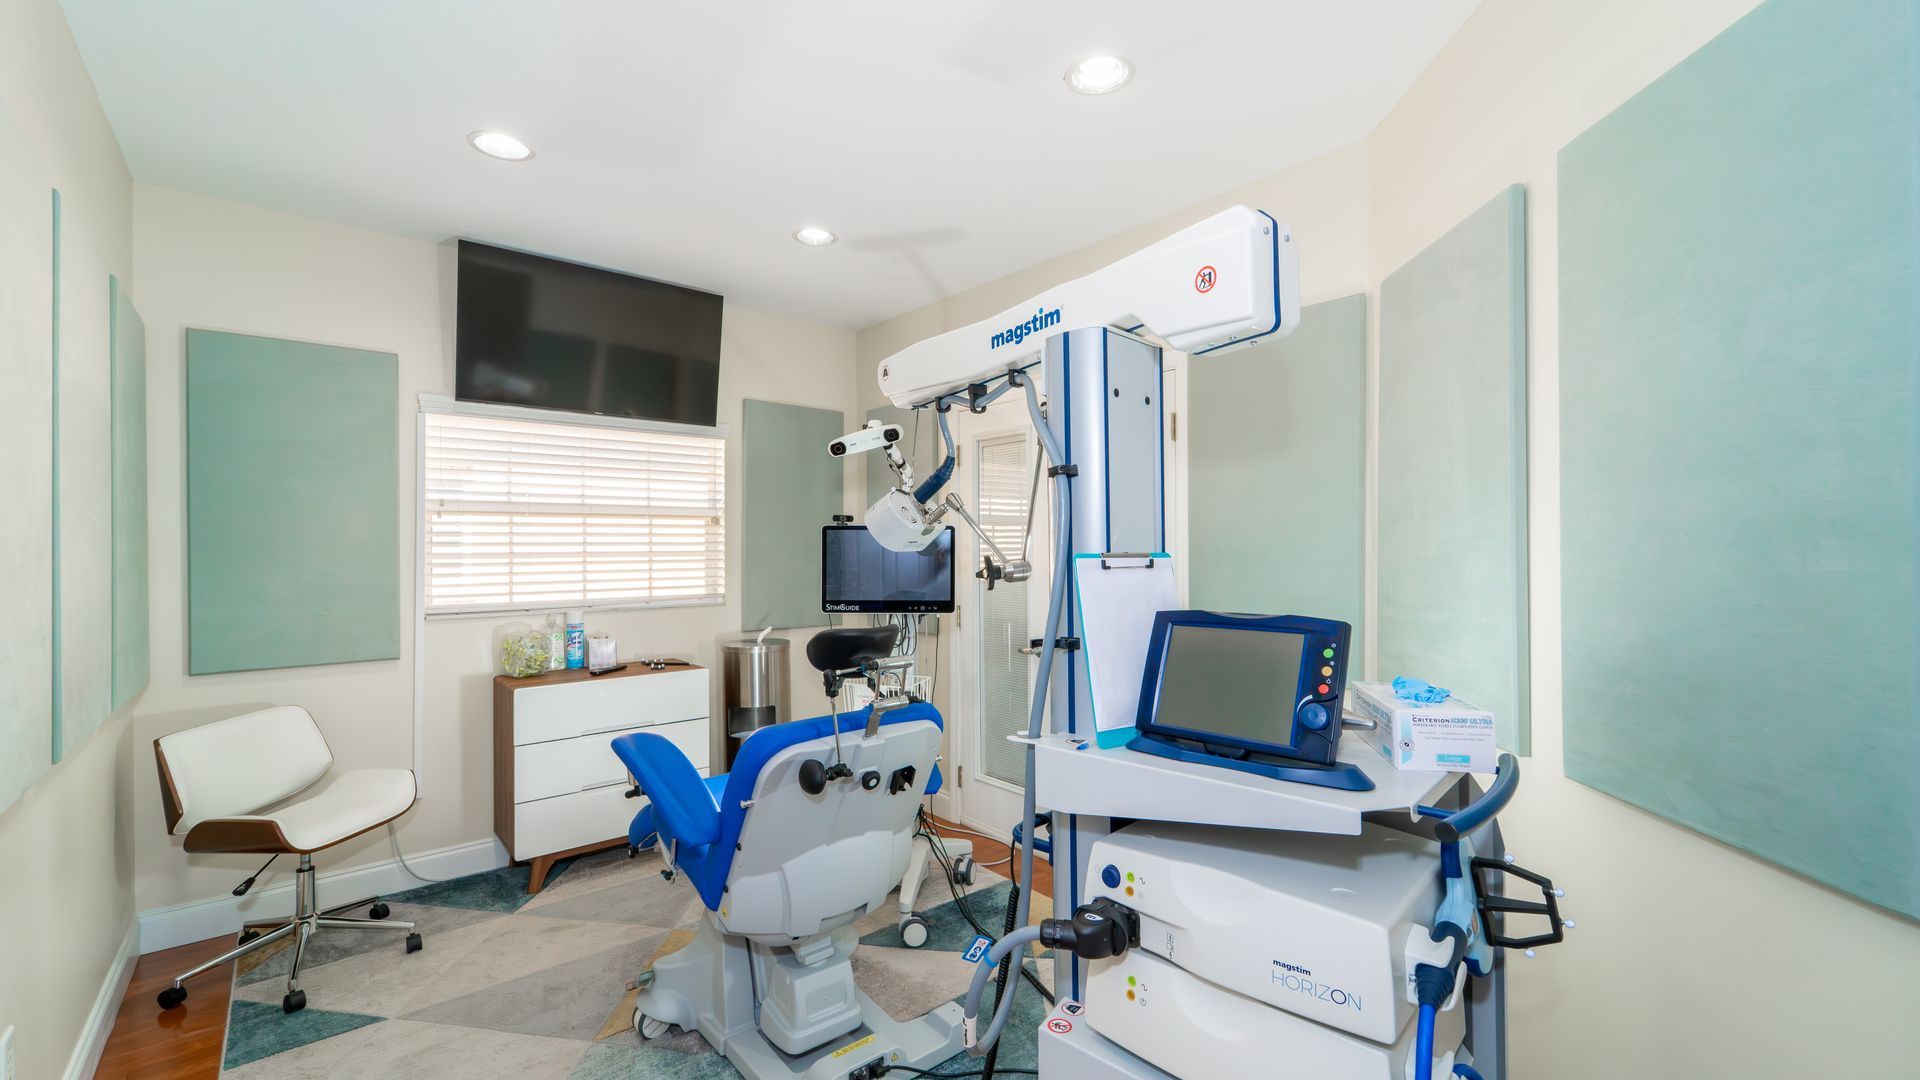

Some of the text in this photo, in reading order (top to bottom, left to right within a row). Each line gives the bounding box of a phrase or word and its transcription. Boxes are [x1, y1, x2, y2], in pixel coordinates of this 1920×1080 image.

[991, 307, 1061, 349] magstim
[1273, 959, 1311, 976] magstim
[1271, 969, 1361, 1011] HORIZON
